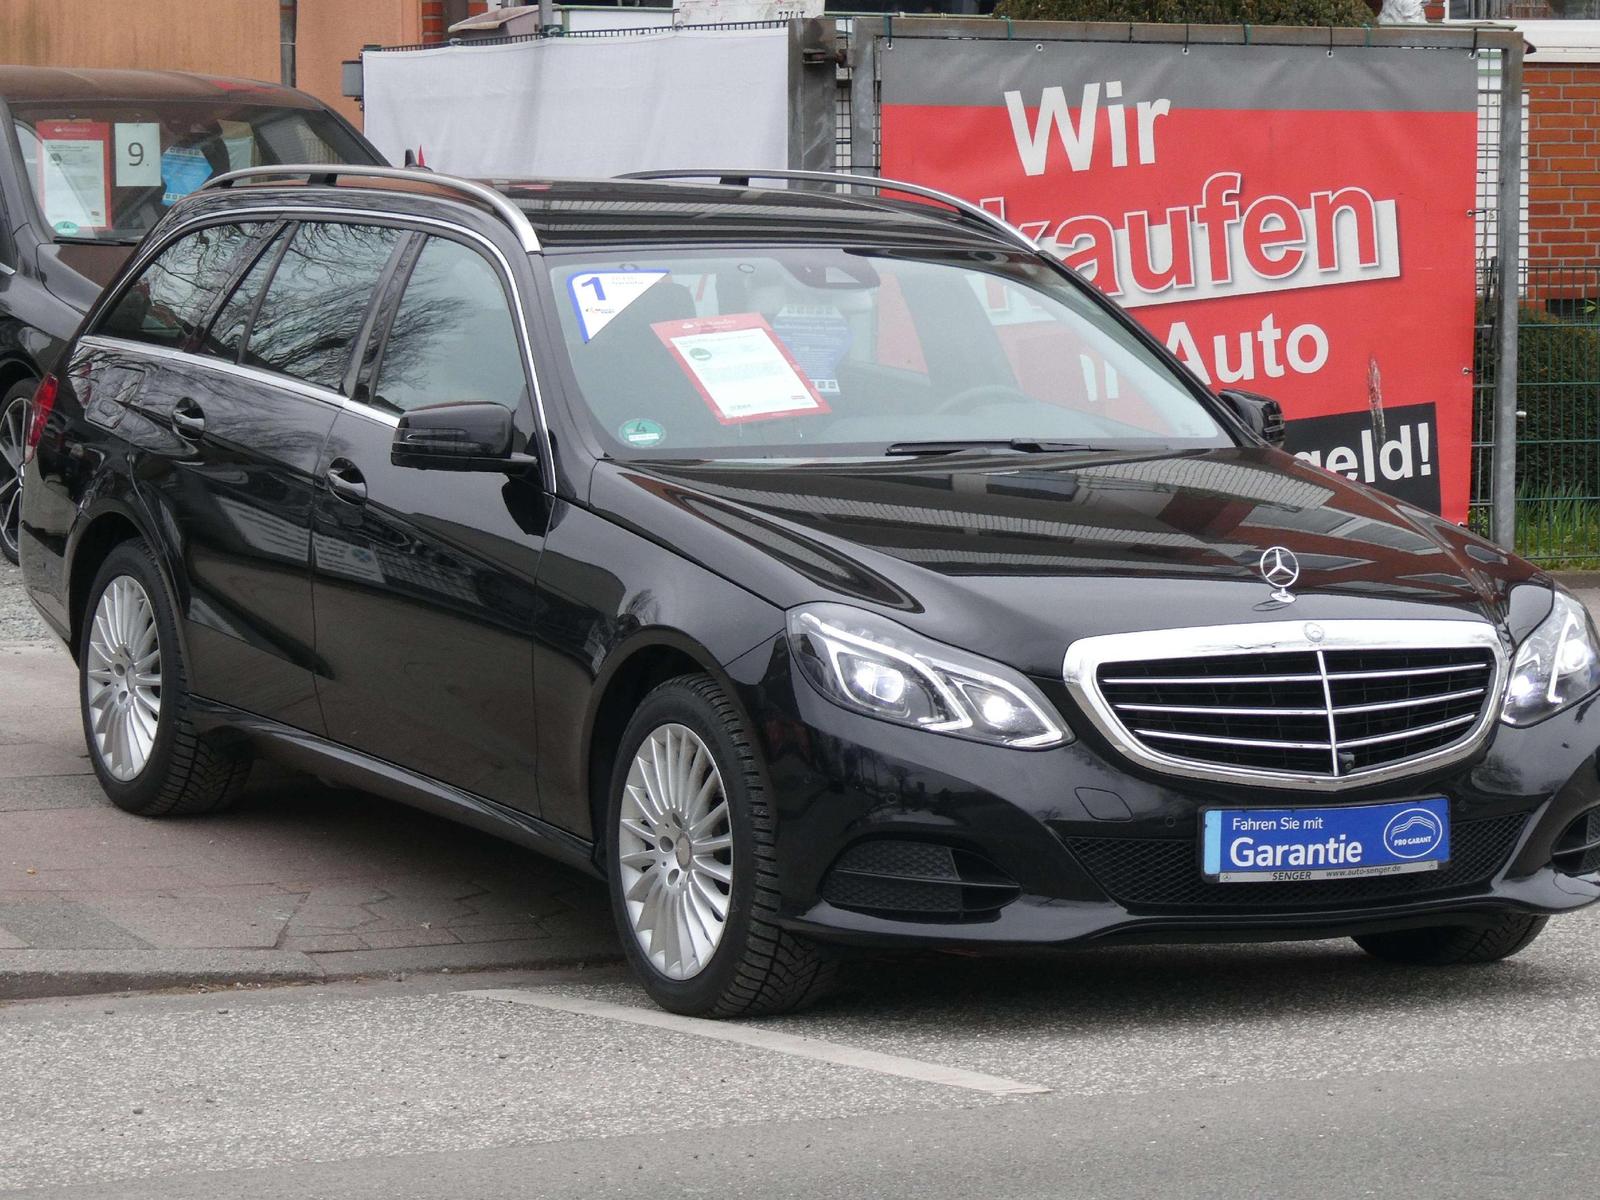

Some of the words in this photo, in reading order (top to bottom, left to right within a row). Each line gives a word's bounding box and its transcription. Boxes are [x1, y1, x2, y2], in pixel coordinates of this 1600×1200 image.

[1004, 81, 1170, 176] Wir
[581, 276, 607, 300] 1
[1165, 312, 1330, 387] Auto
[1232, 817, 1277, 831] Fahren
[1280, 816, 1300, 830] Sie
[1303, 816, 1324, 830] mit
[1229, 834, 1363, 868] Garantie
[1393, 838, 1407, 847] PRO
[1407, 836, 1432, 846] GARANT
[1271, 871, 1312, 881] SENGER
[1325, 864, 1401, 878] www.auto-senger.de
